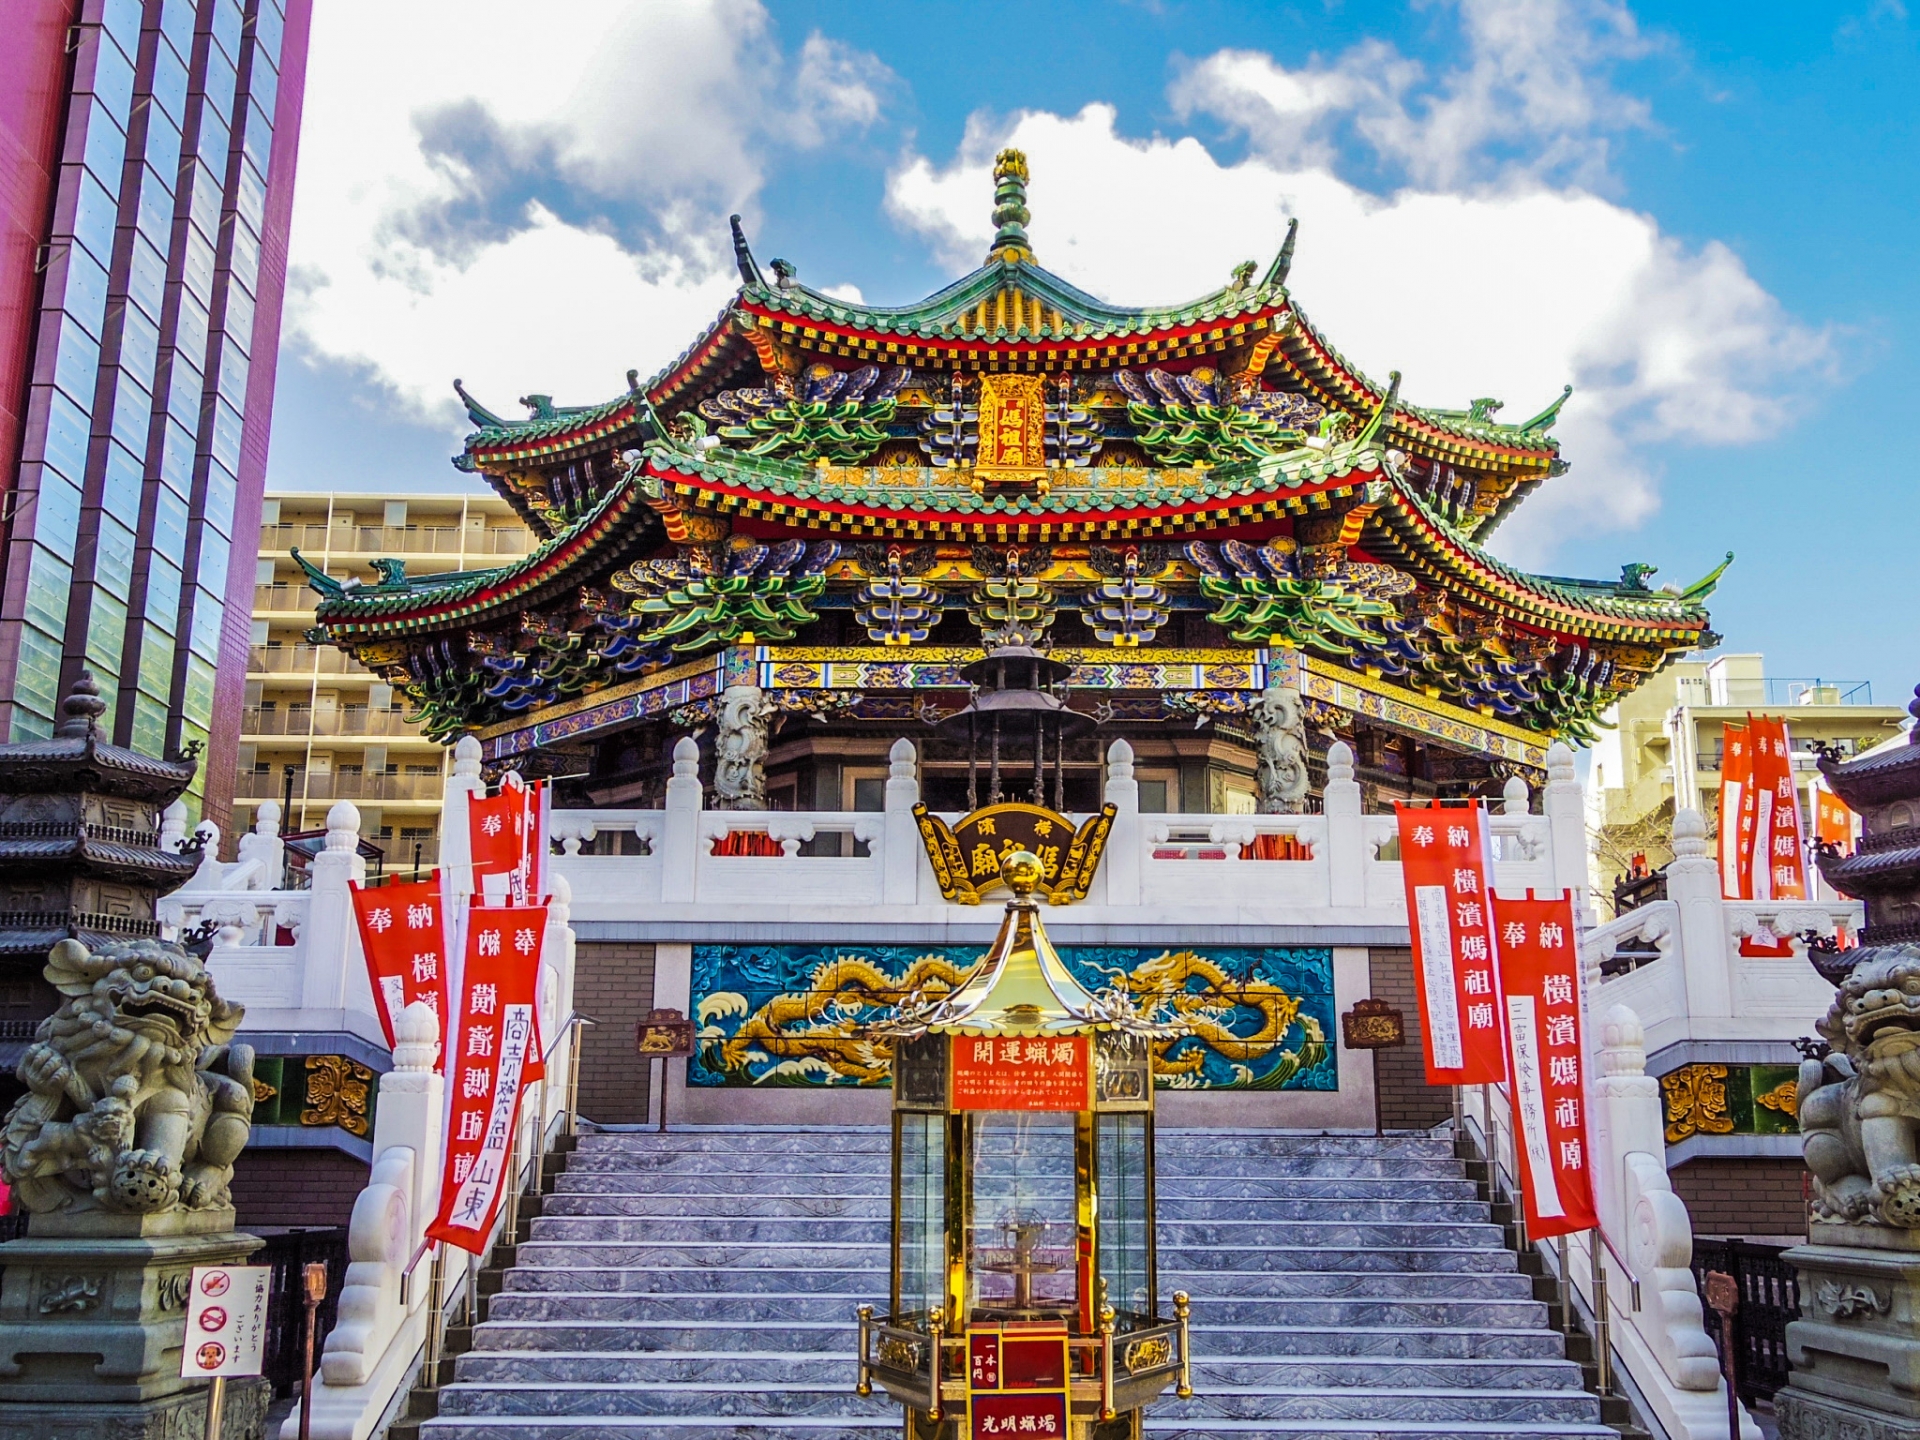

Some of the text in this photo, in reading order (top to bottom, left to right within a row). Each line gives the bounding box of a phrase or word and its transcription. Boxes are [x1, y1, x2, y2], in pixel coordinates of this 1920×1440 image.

[999, 408, 1024, 465] 媽祖廟
[1411, 825, 1470, 848] 奉納
[367, 902, 433, 934] 奉納
[1503, 921, 1564, 949] 奉納
[973, 1040, 1075, 1066] 開運蝋燭
[250, 1273, 266, 1353] ご協力ありがとう
[231, 1314, 246, 1364] ございます
[972, 1354, 984, 1381] 百円
